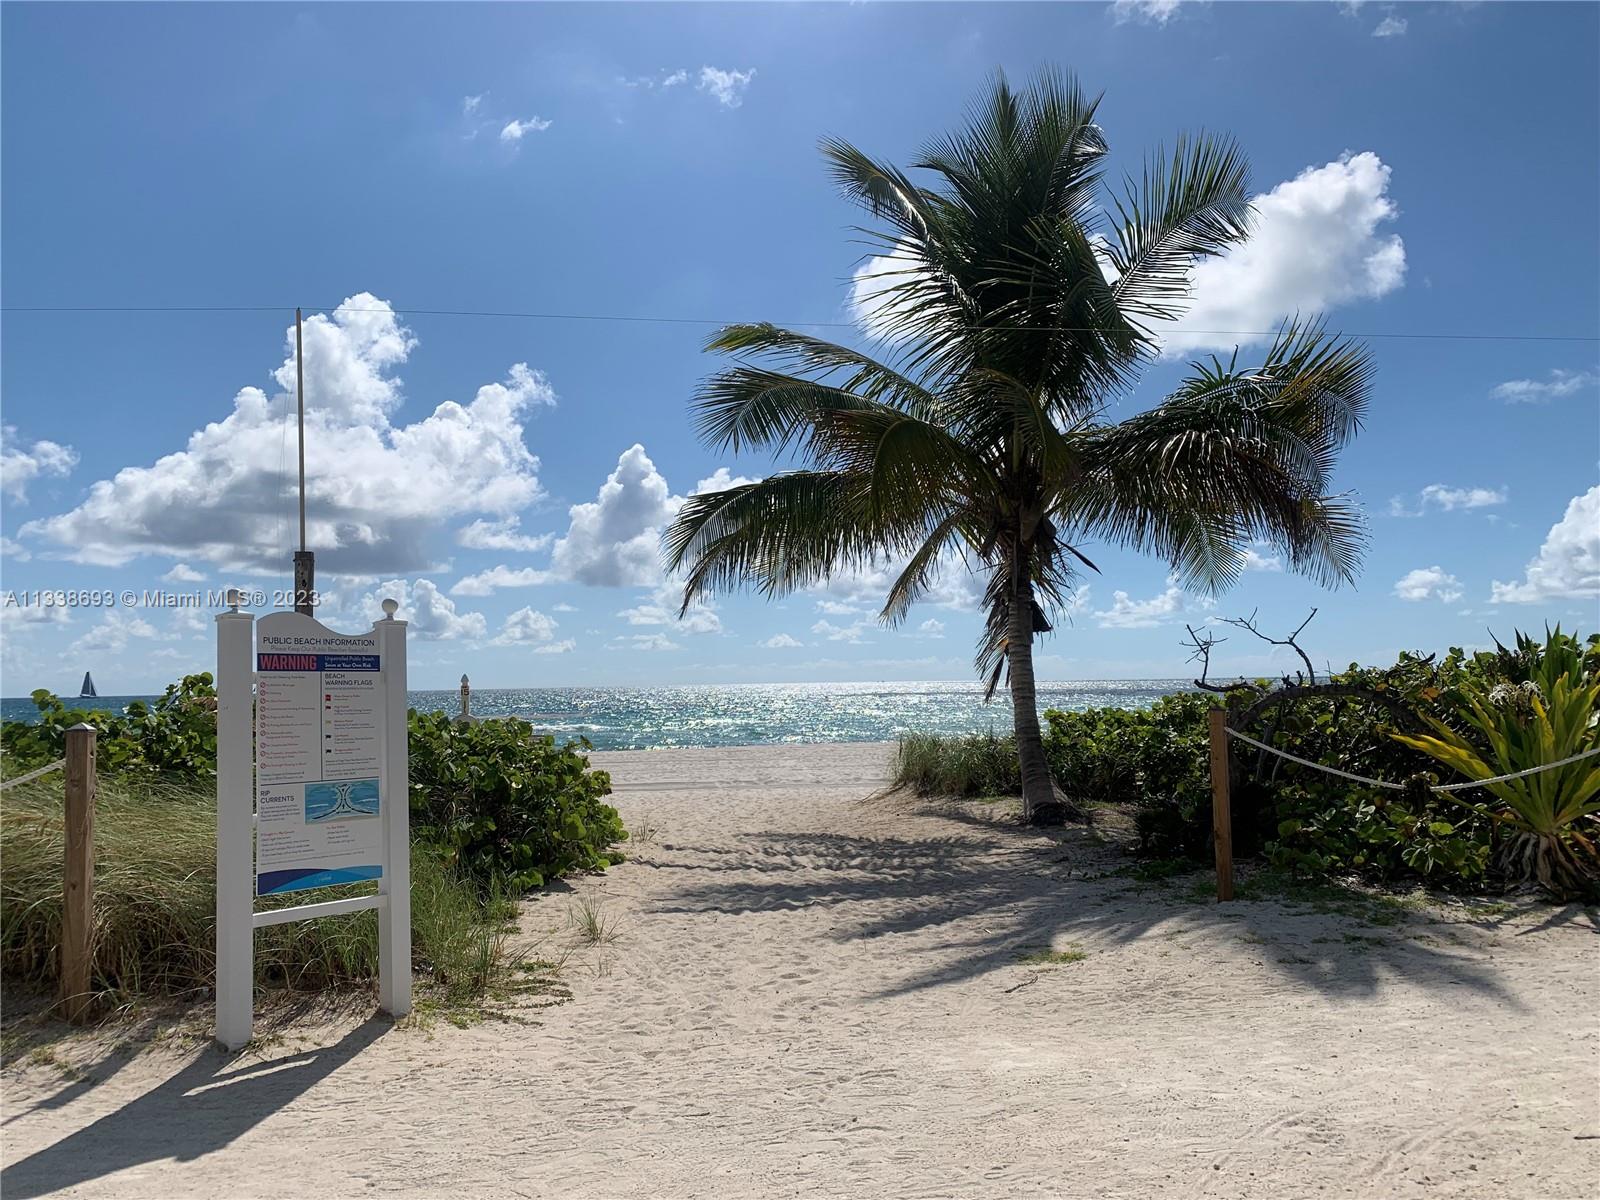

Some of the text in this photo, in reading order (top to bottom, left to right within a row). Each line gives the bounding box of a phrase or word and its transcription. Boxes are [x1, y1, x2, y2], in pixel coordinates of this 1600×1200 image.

[263, 636, 375, 647] PUBLIC BEACH INFORMATION
[260, 655, 317, 670] WARNING
[260, 795, 295, 804] CURRENTS
